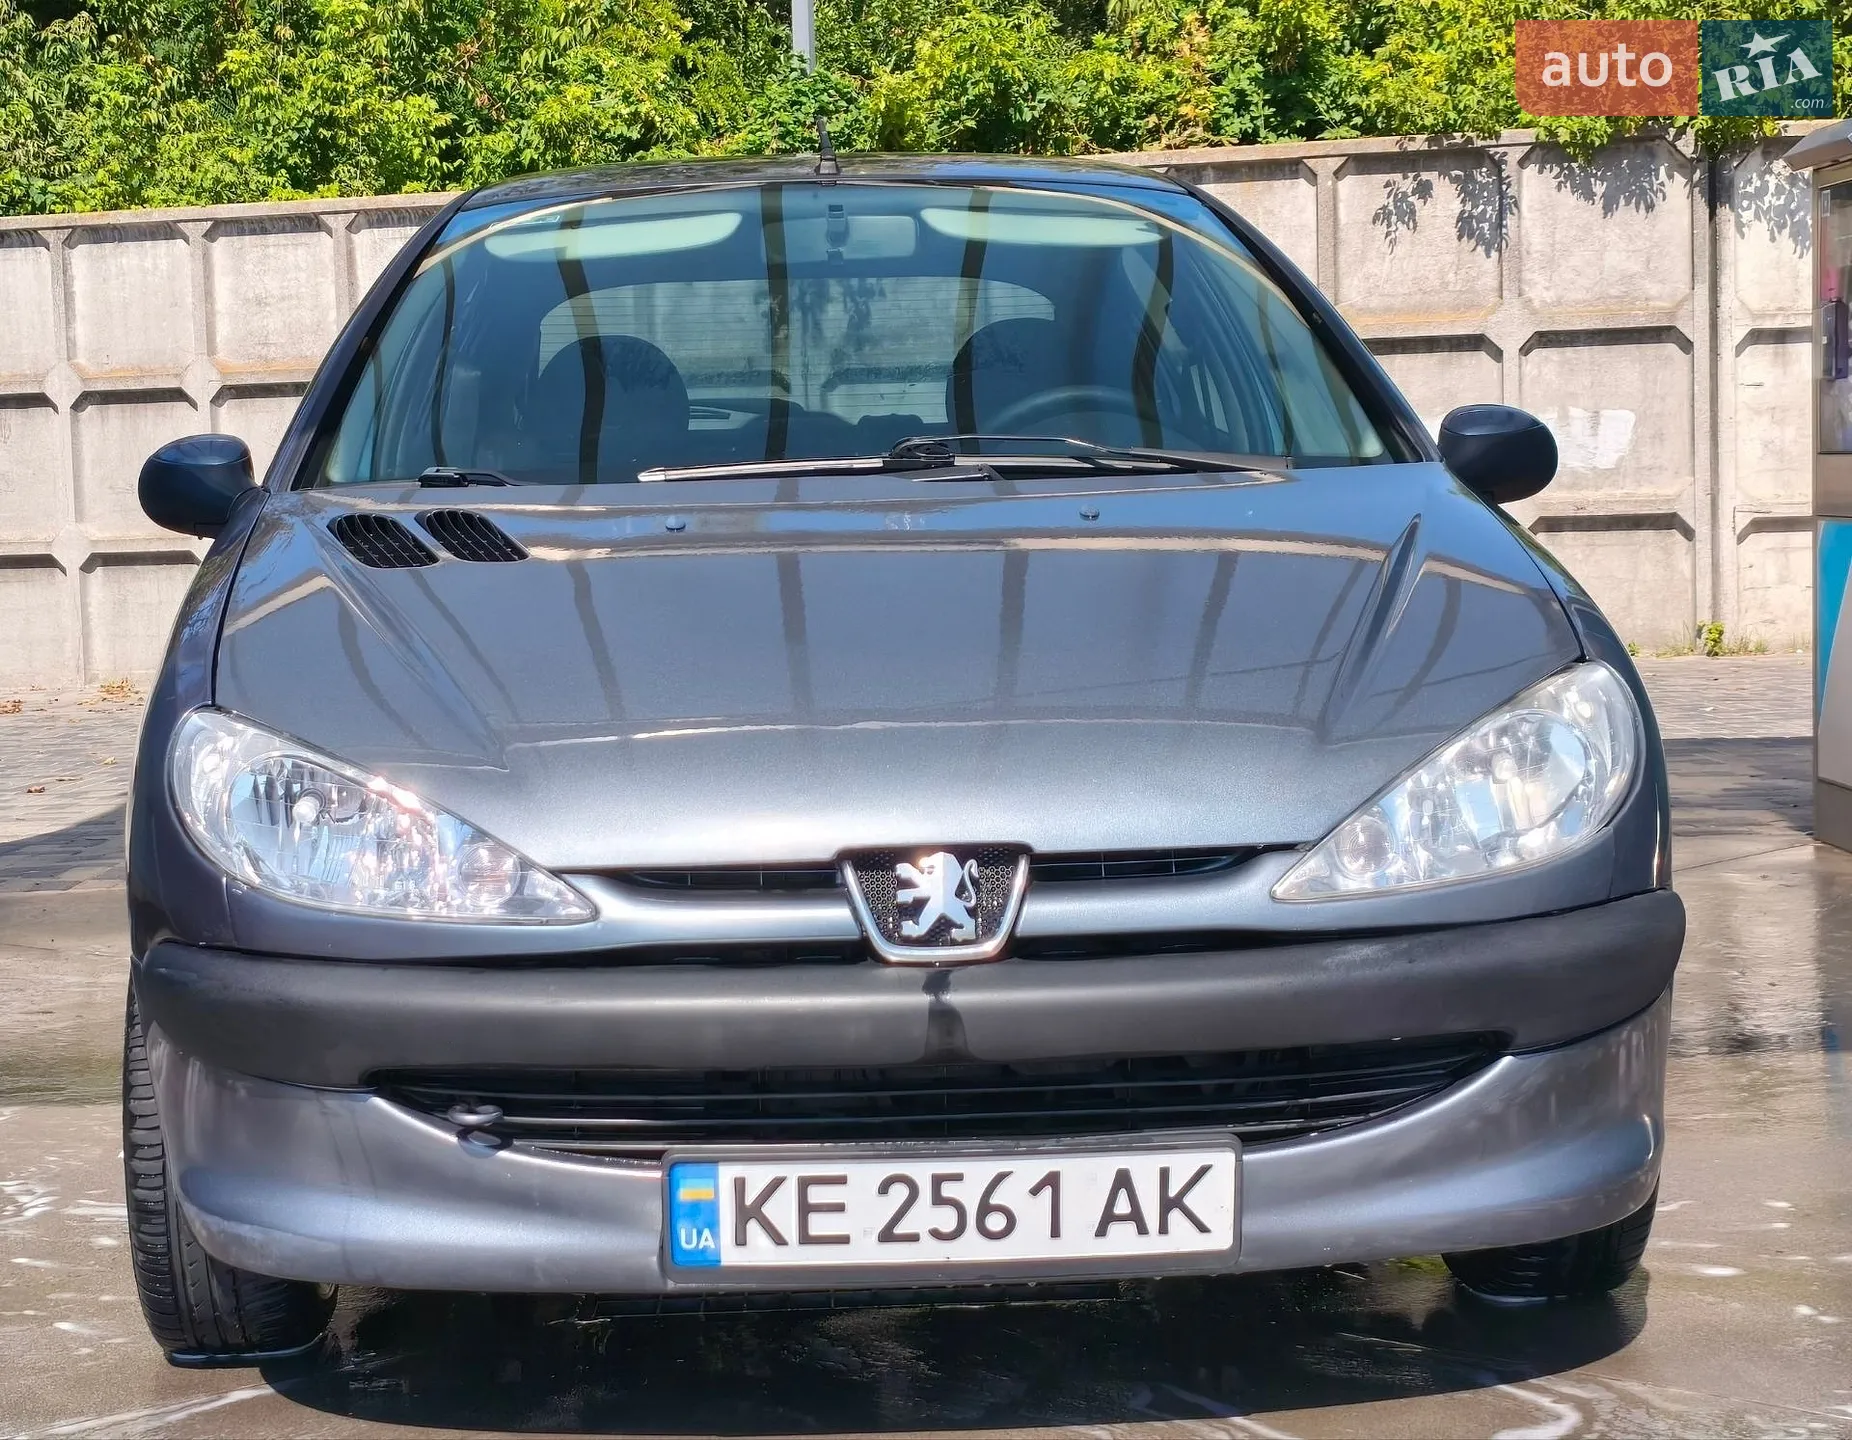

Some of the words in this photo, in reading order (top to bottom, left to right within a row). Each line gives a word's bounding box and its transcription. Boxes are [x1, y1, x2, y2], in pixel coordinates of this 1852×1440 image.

[733, 1174, 851, 1246] KE
[877, 1170, 1061, 1242] 2561
[1094, 1164, 1213, 1238] AK
[680, 1227, 716, 1250] UA
